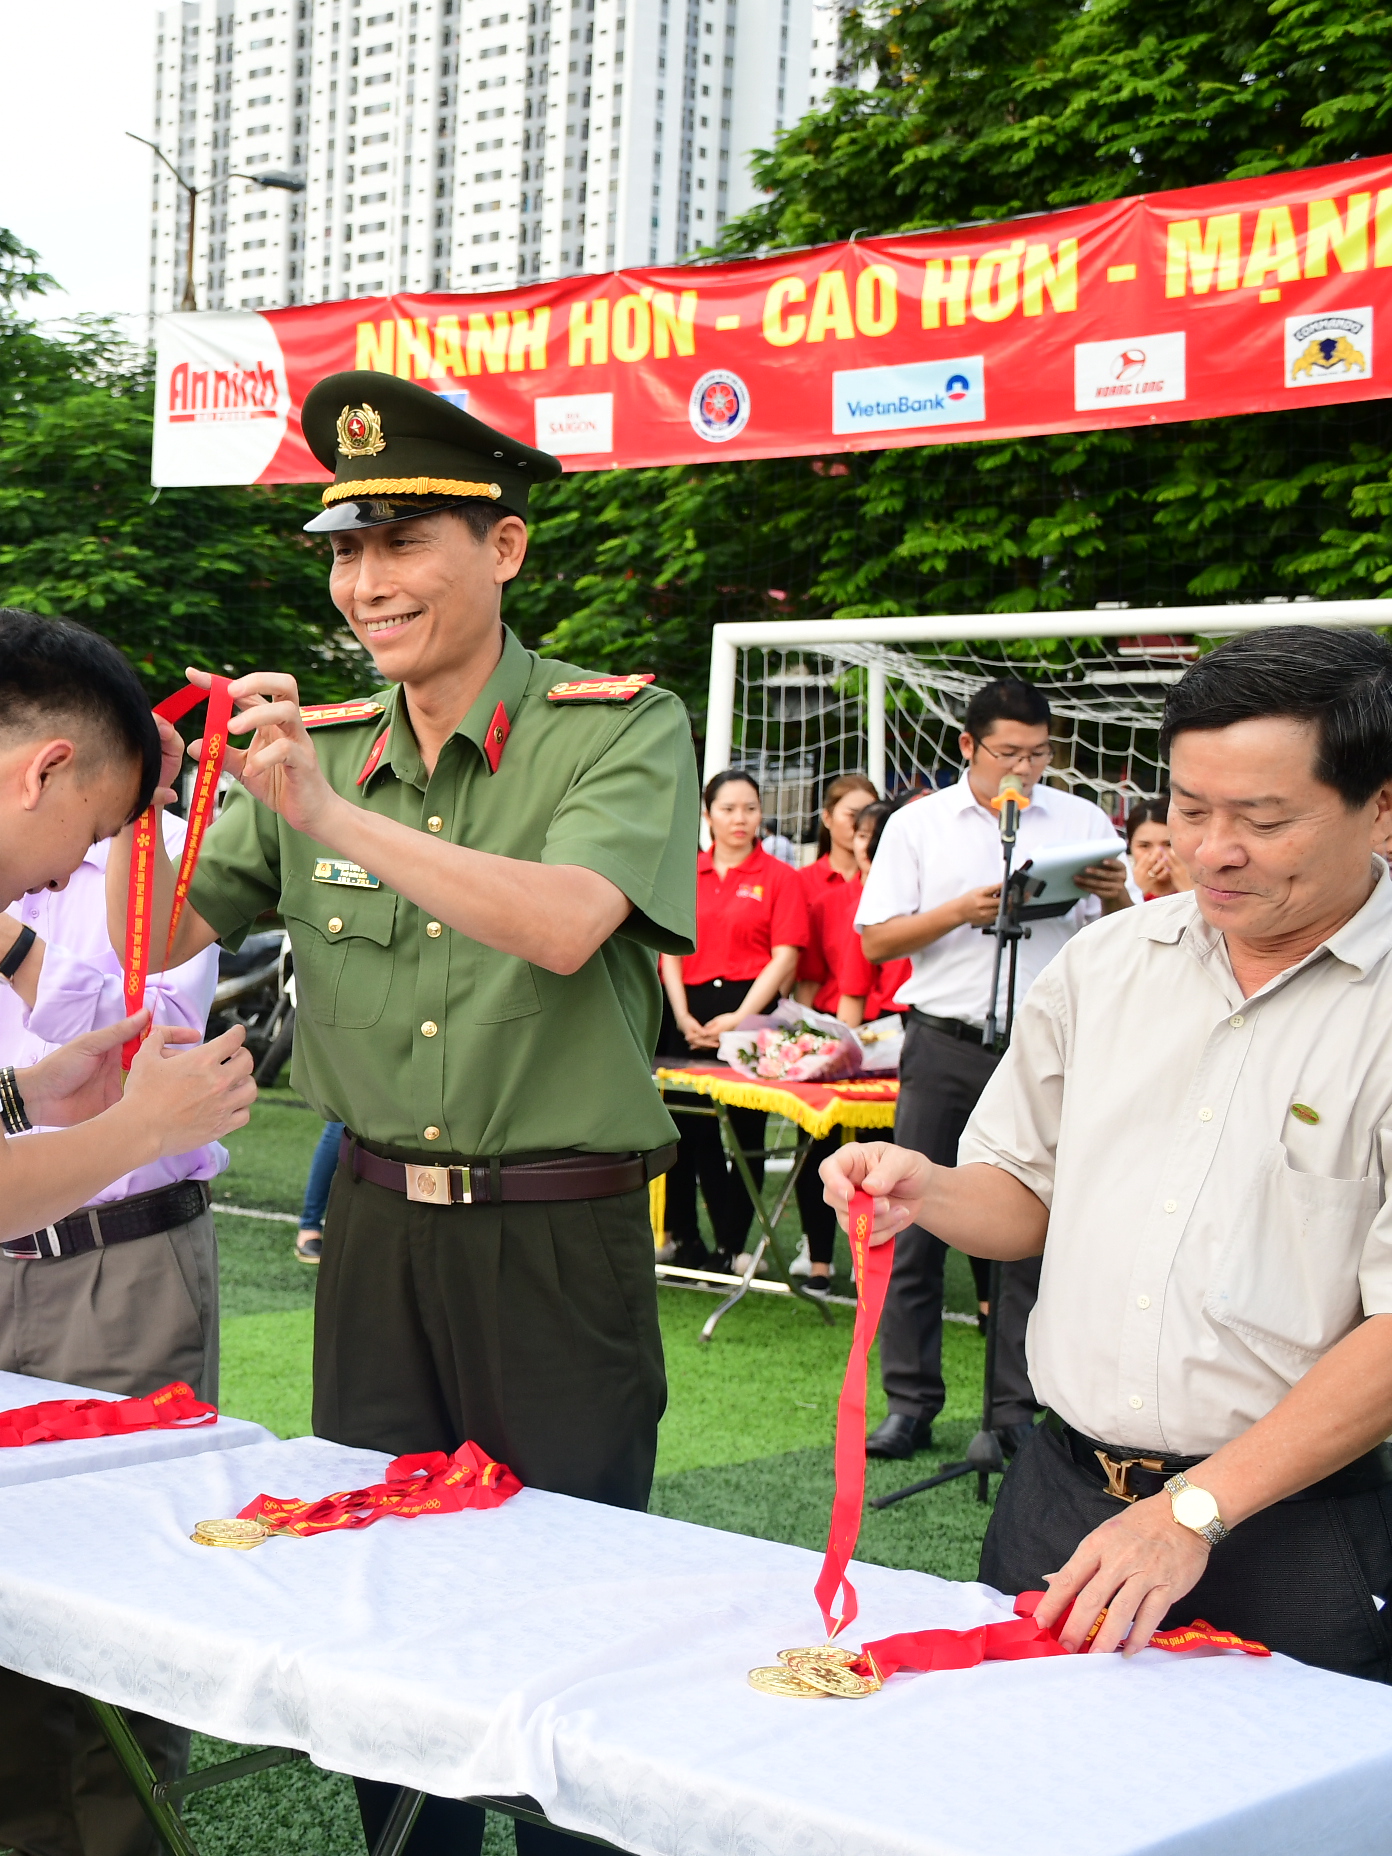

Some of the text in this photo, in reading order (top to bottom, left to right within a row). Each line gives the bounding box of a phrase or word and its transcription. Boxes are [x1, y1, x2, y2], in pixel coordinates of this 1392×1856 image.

[355, 307, 550, 379] NHANH
[568, 286, 698, 367] HƠN
[762, 264, 898, 347] CAO
[921, 238, 1078, 330] HƠN
[847, 394, 945, 417] VietinBank
